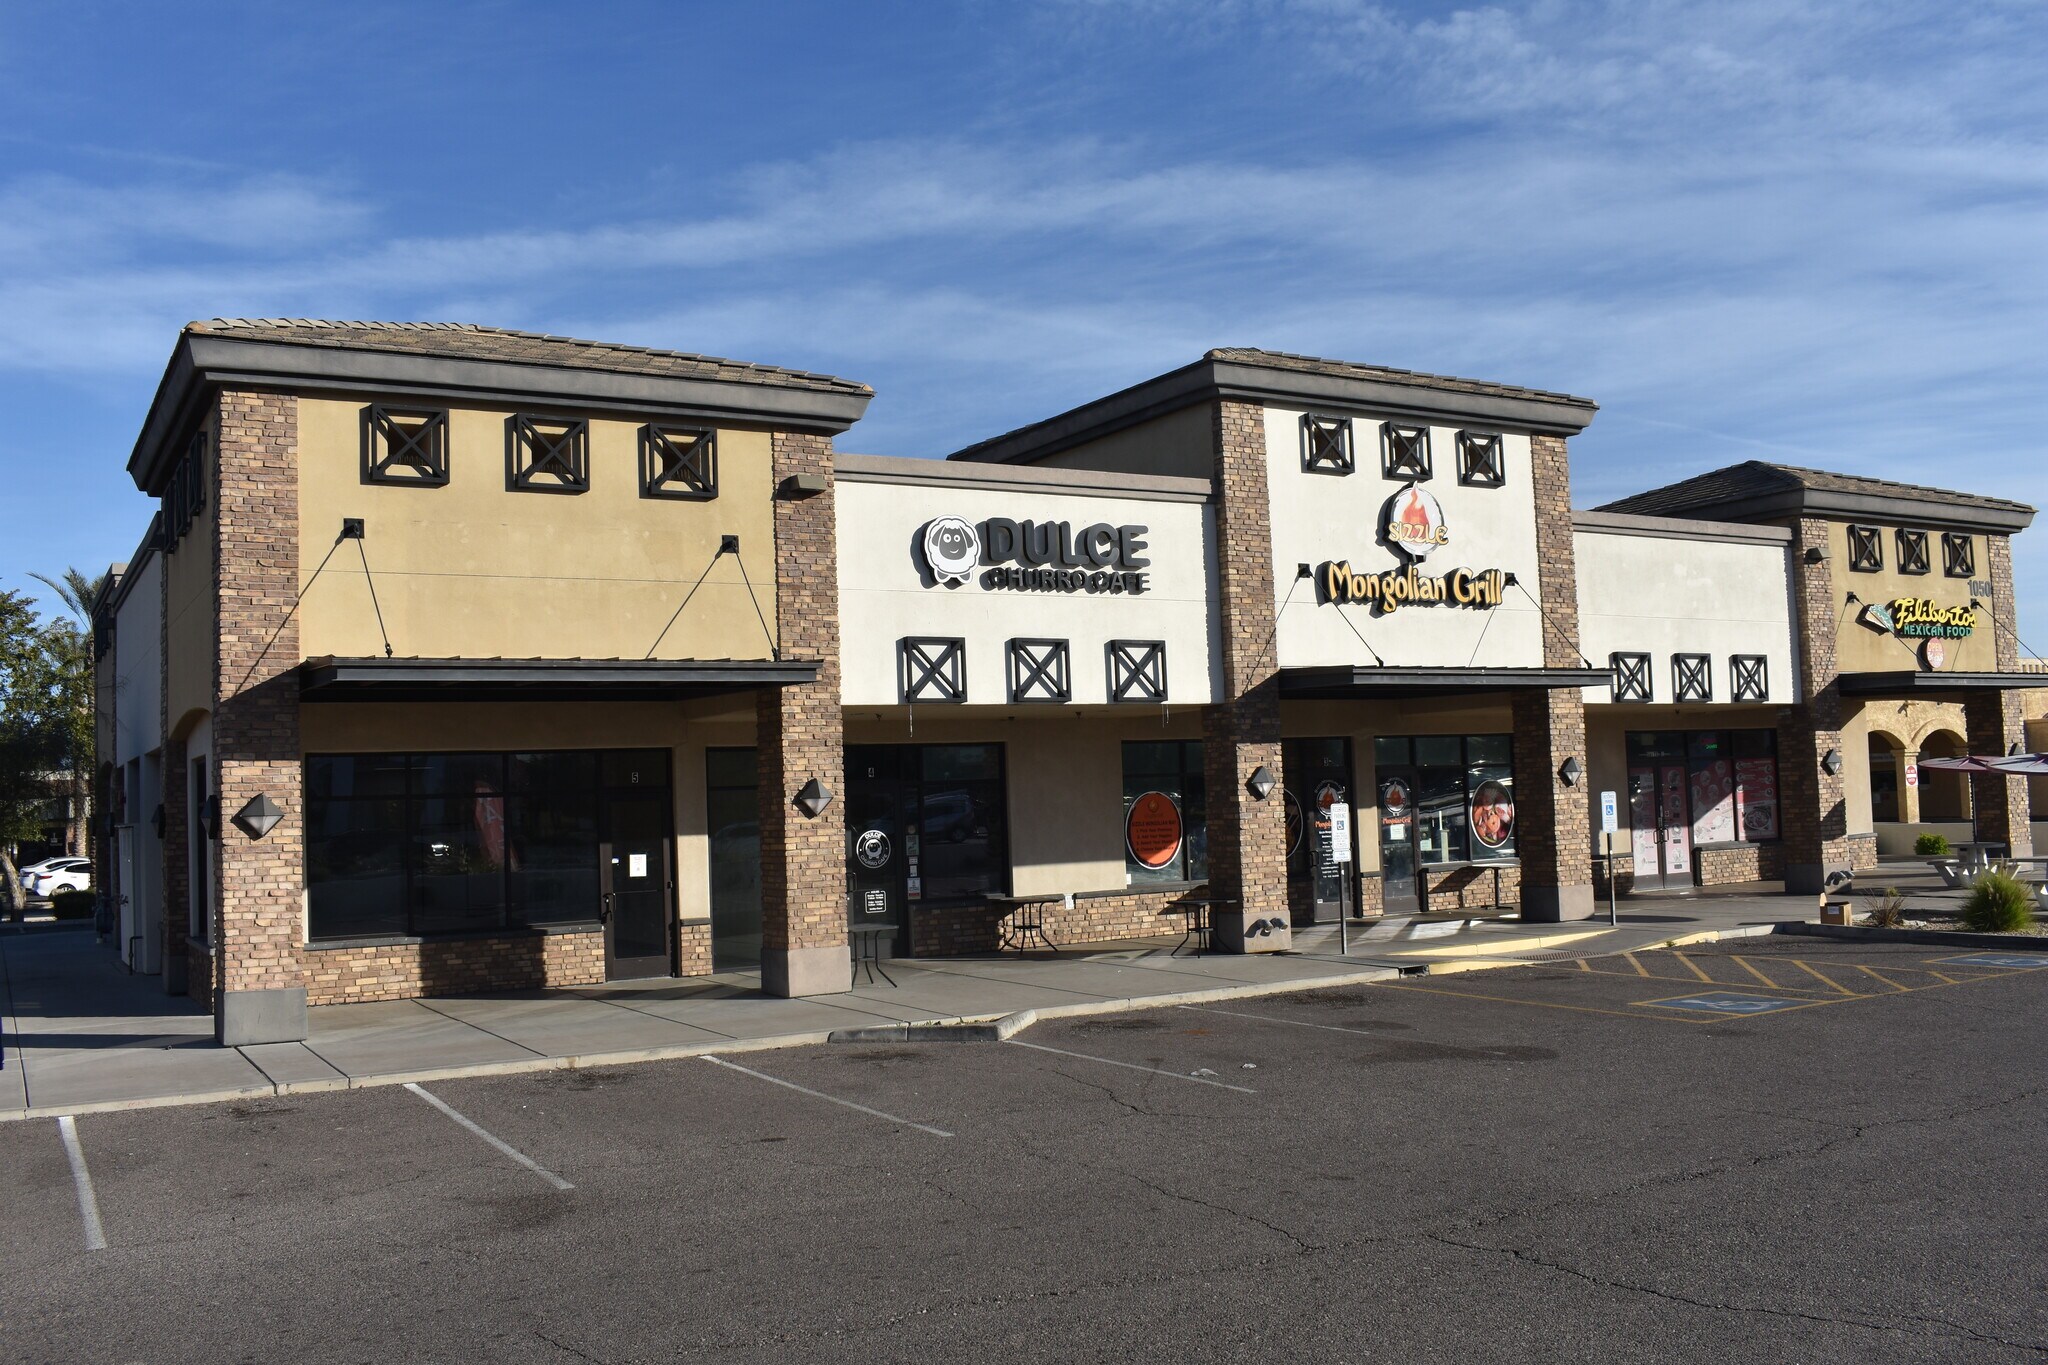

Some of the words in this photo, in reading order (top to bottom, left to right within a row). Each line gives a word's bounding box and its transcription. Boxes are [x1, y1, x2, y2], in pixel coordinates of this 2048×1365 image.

[985, 517, 1151, 567] DULCE
[1388, 521, 1449, 546] SIZZLE
[990, 567, 1088, 590] CHURRO
[1092, 571, 1151, 592] CAFE
[1327, 561, 1447, 613] Mongolian
[1453, 566, 1502, 605] Grill
[1968, 580, 1992, 597] 1050
[1894, 598, 1977, 630] Filiberto's
[1903, 624, 1944, 637] MEXICAN
[1946, 627, 1973, 637] FOOD
[631, 772, 639, 784] 5
[864, 831, 882, 840] DULCE
[877, 854, 888, 865] CAFE
